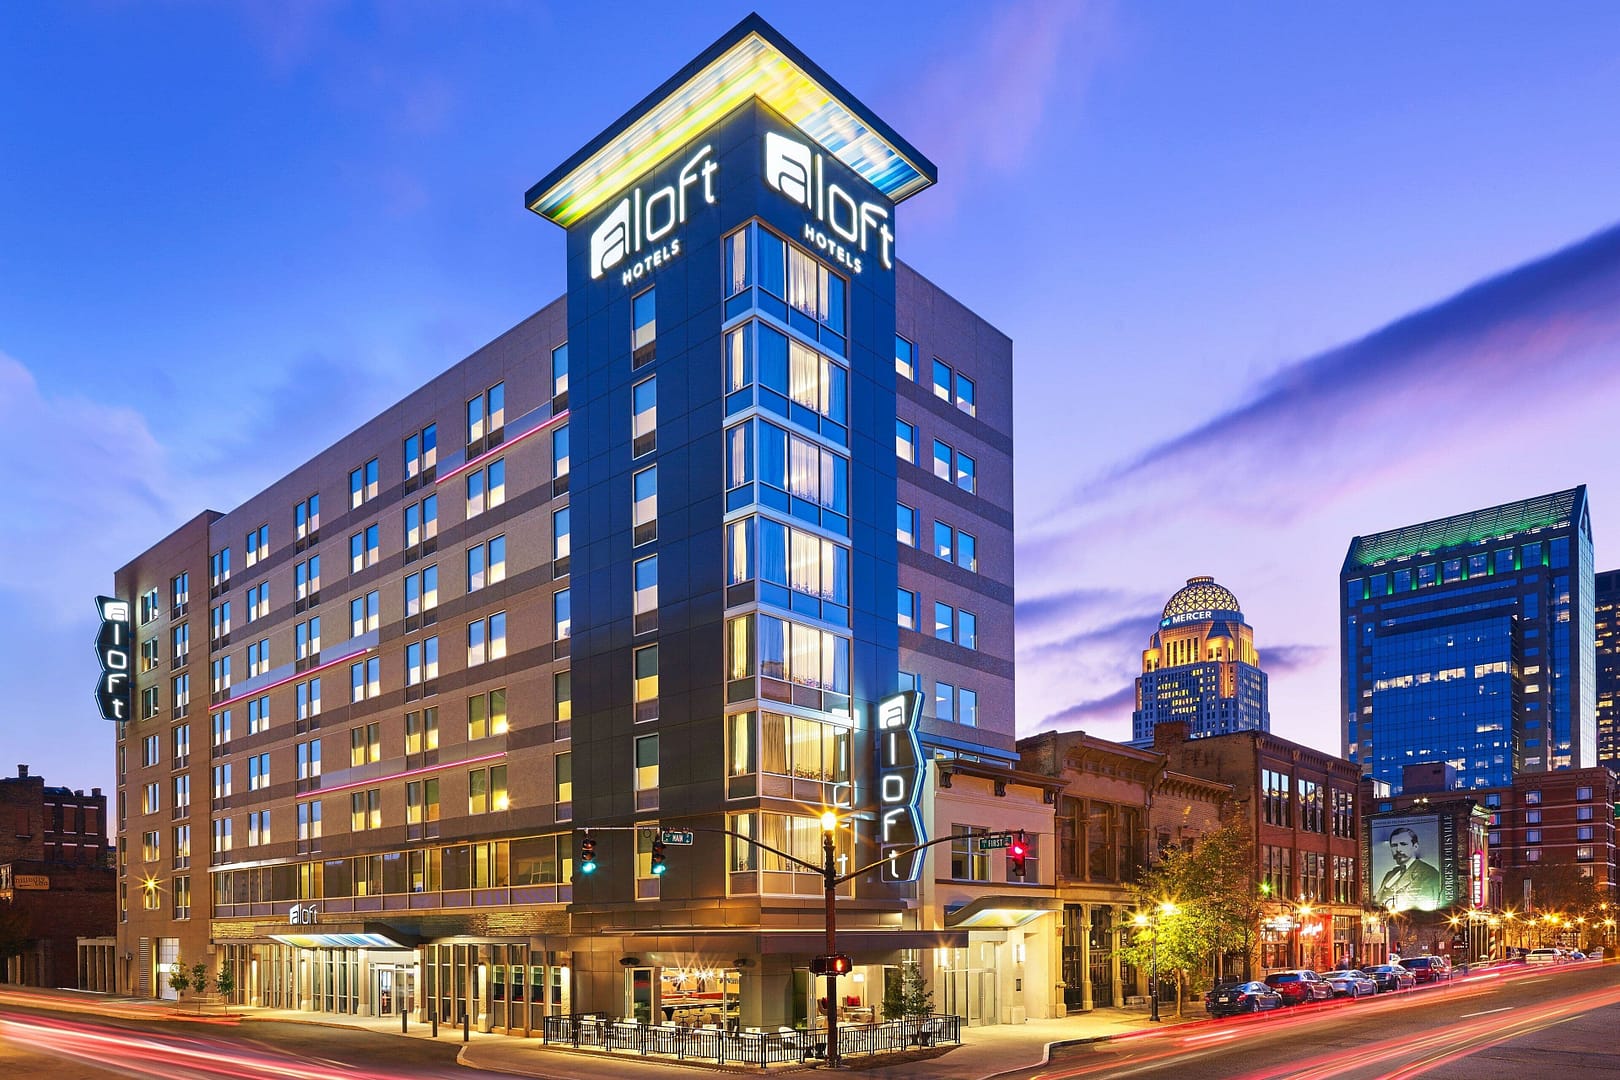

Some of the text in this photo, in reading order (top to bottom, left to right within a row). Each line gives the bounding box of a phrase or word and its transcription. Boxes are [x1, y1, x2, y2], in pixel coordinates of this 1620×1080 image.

[804, 223, 863, 274] HOTELS
[622, 239, 681, 286] HOTELS
[1172, 610, 1212, 624] MERCER
[672, 834, 683, 842] MAIN
[988, 839, 1003, 848] FIRST
[1444, 863, 1454, 901] GEORGE'S
[289, 903, 318, 925] aloft
